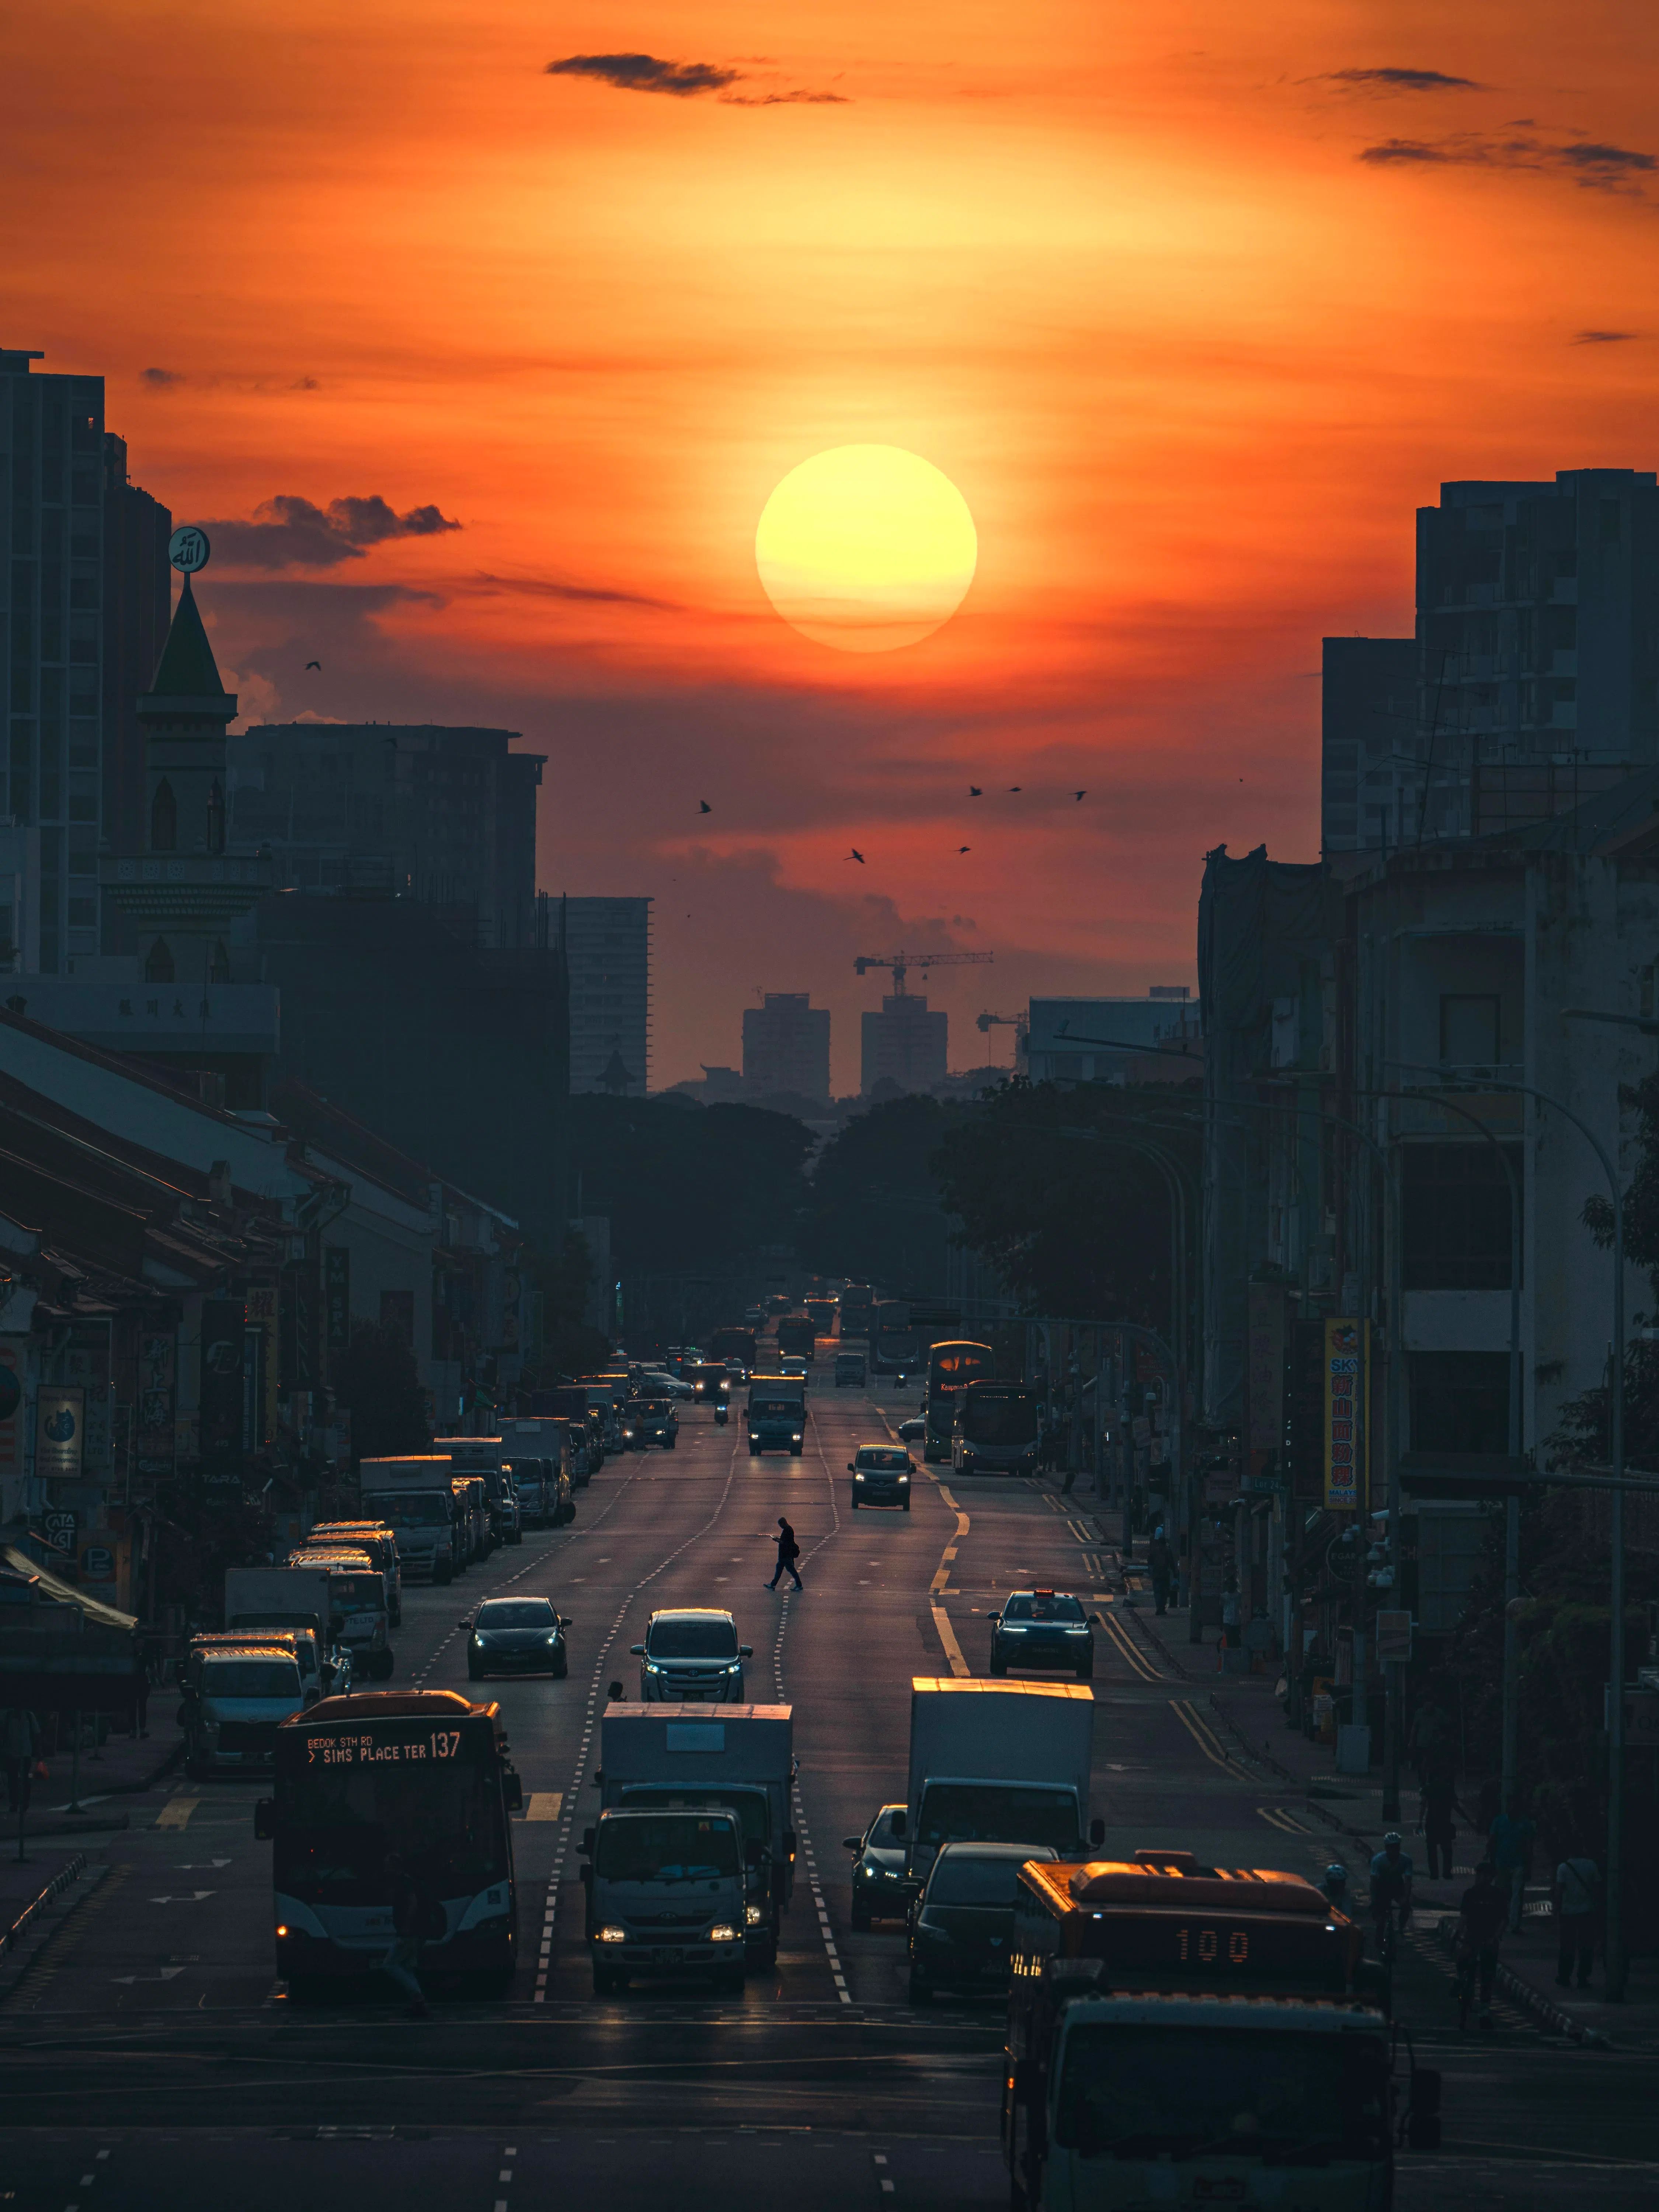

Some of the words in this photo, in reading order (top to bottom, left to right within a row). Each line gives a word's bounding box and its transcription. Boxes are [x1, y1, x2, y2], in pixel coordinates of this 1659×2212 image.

[144, 1338, 170, 1427] 新上海
[202, 1474, 240, 1483] TARA
[1255, 1478, 1267, 1488] Lor
[307, 1738, 336, 1749] BEDOK
[340, 1737, 357, 1747] STH
[361, 1736, 372, 1746] RD
[430, 1731, 460, 1758] 137
[324, 1748, 352, 1763] SIMS
[361, 1746, 399, 1761] PLACE
[404, 1745, 426, 1759] TER
[1176, 1929, 1248, 1962] 100
